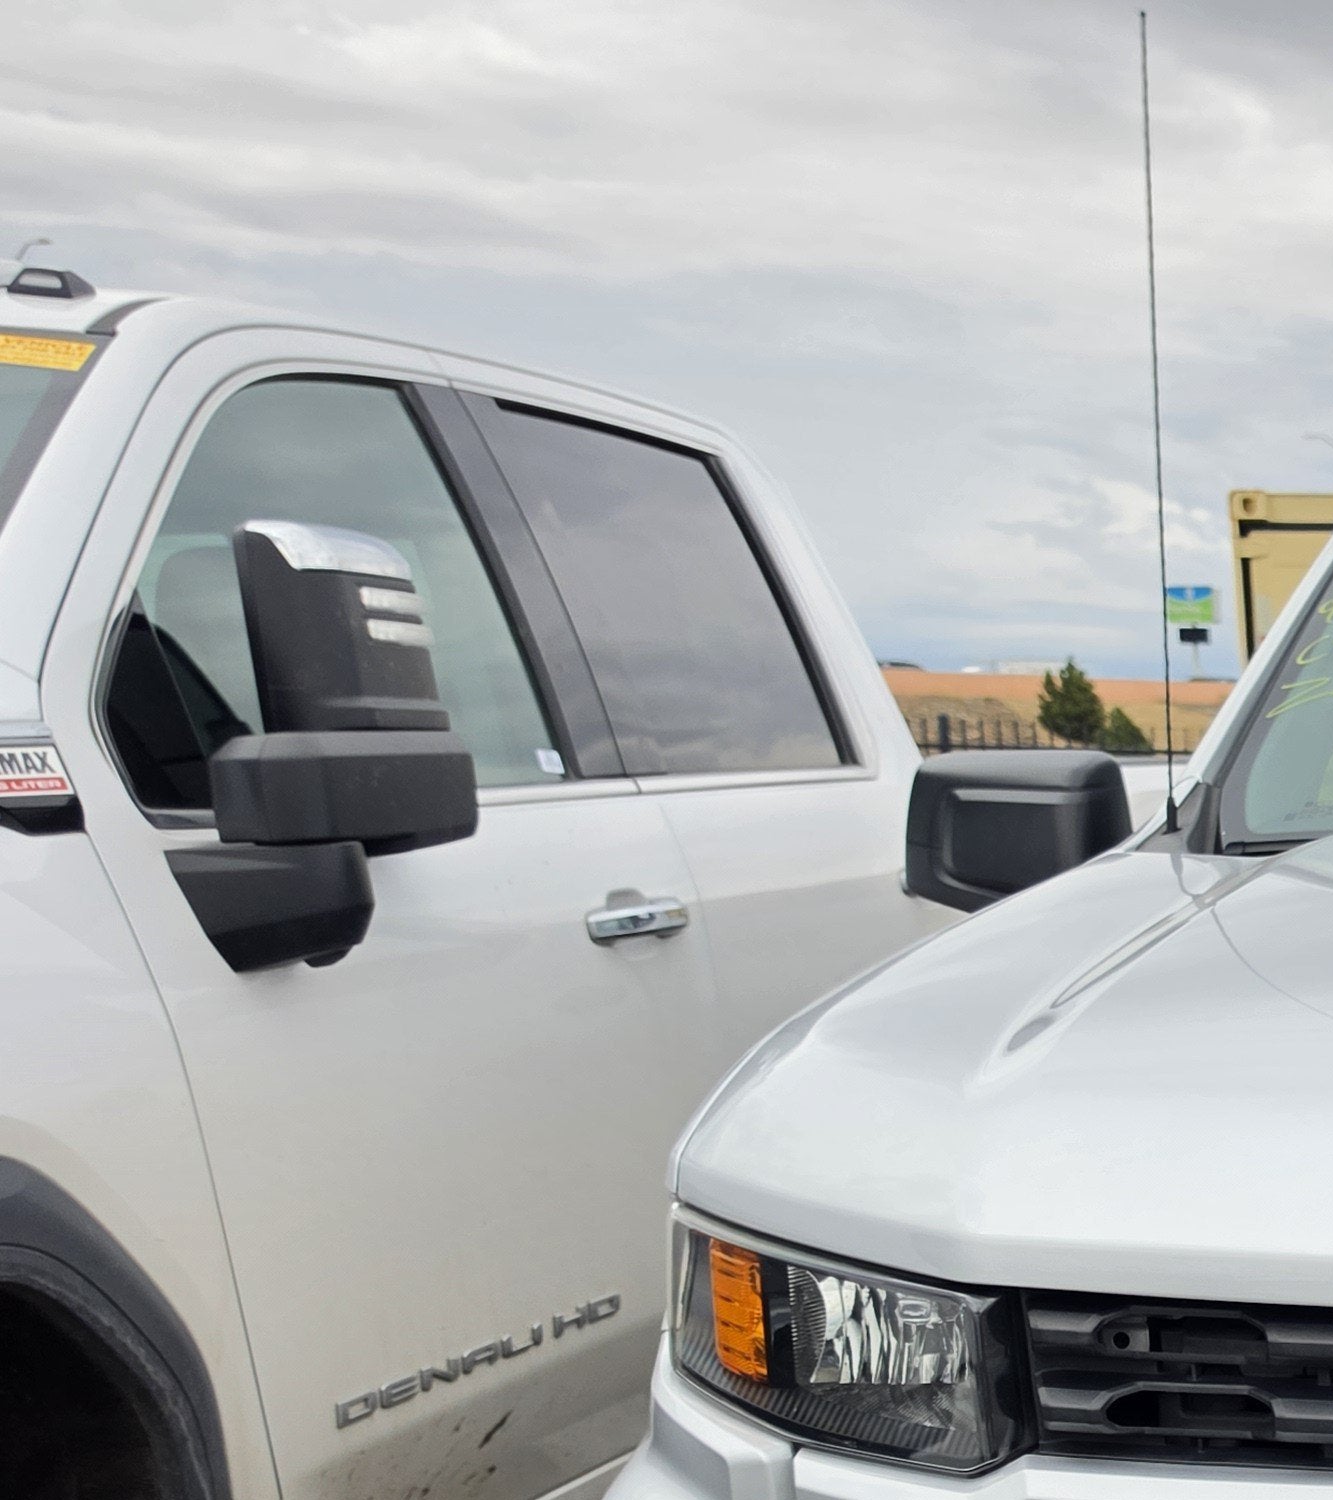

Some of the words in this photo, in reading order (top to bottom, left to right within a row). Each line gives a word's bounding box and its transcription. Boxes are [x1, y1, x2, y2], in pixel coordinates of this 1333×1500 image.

[11, 780, 61, 790] LITER
[335, 1322, 543, 1430] DENALI
[553, 1294, 621, 1339] HD
